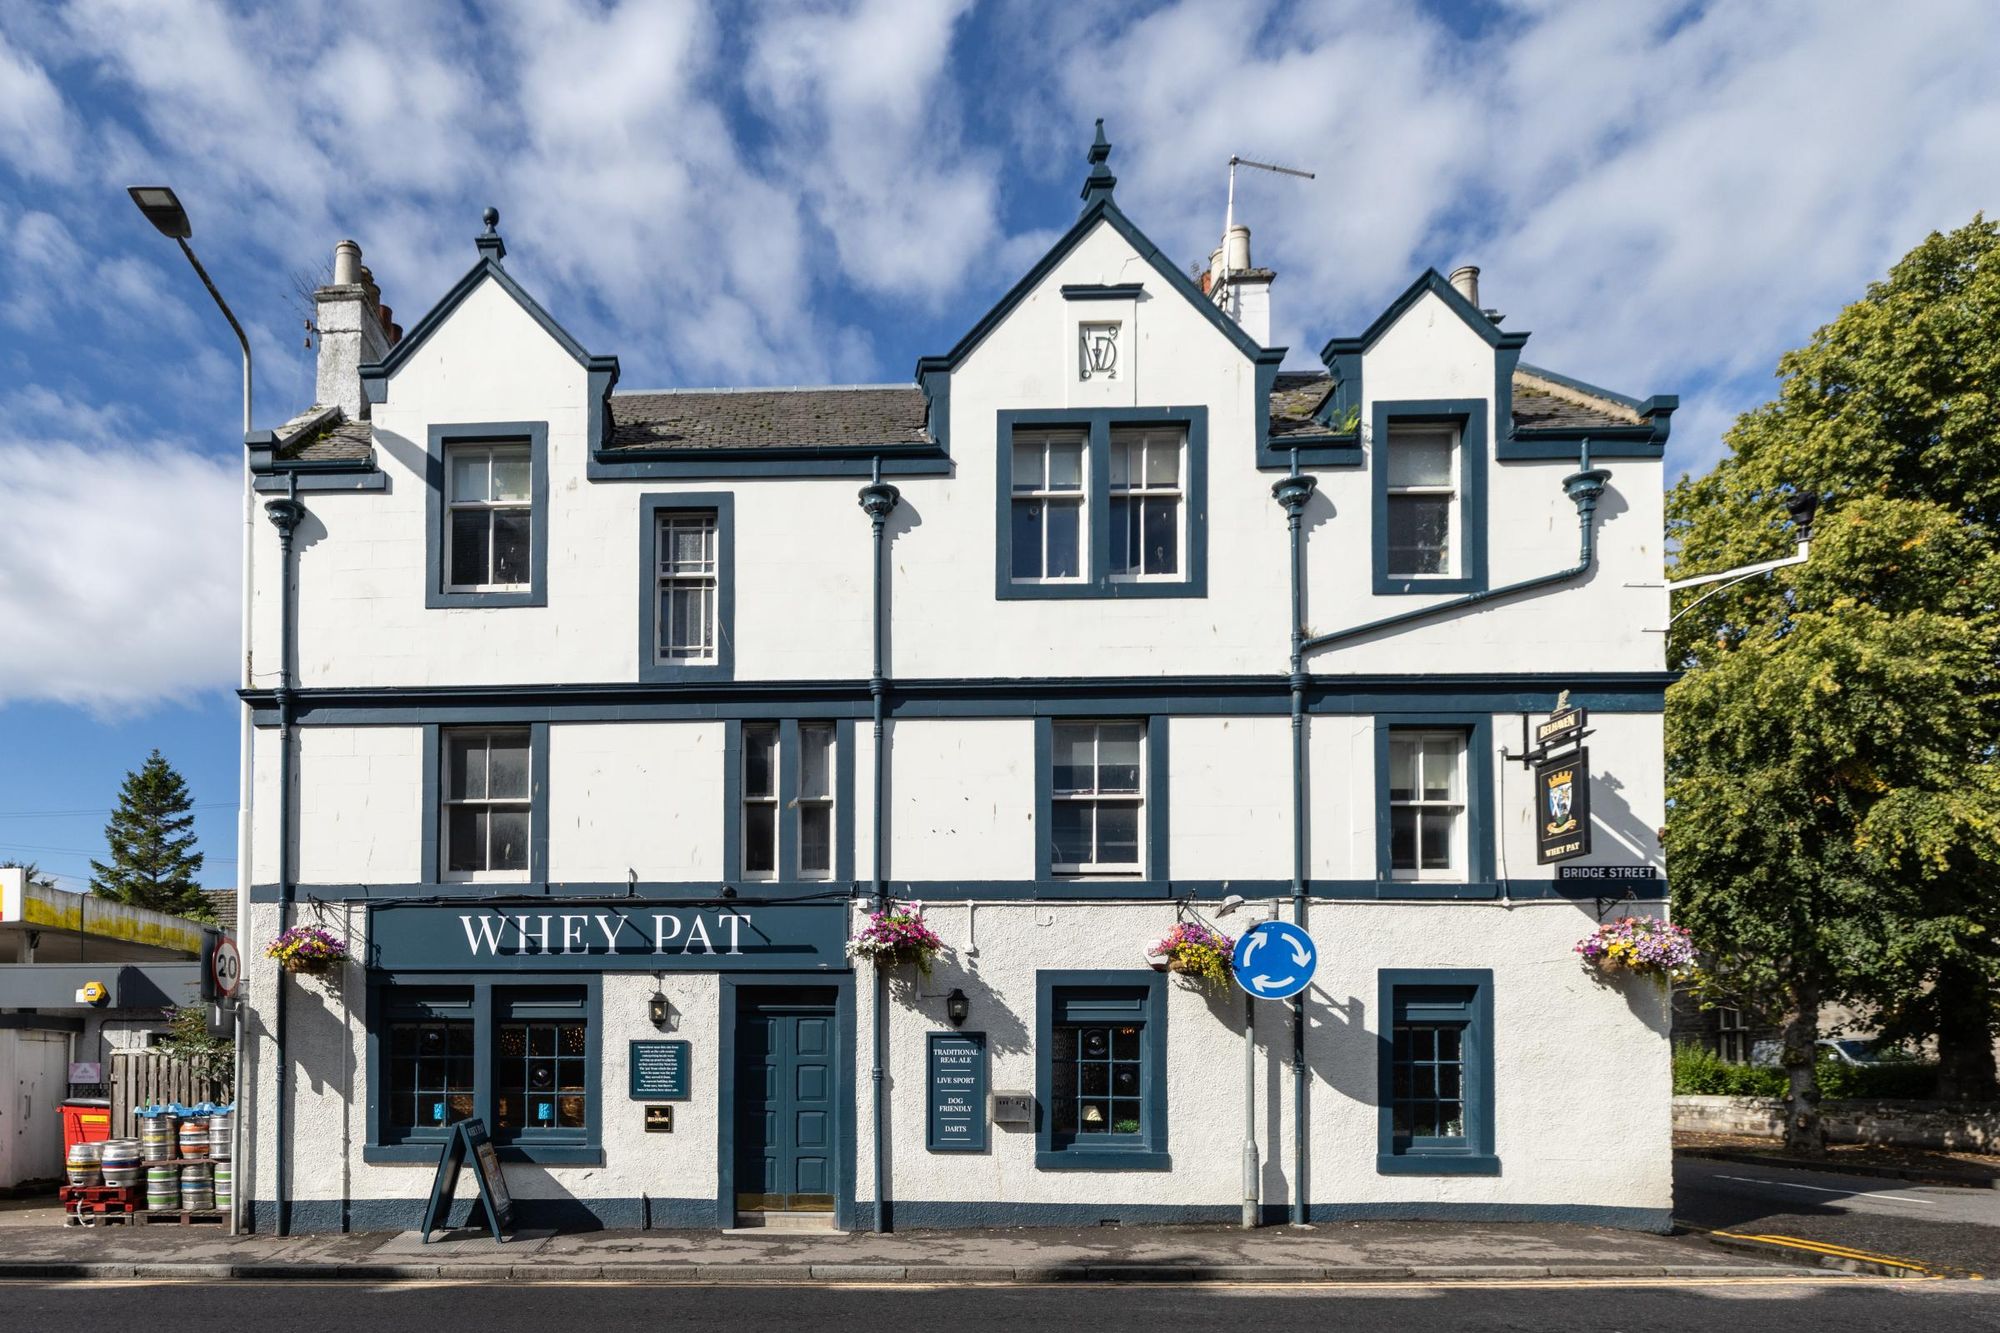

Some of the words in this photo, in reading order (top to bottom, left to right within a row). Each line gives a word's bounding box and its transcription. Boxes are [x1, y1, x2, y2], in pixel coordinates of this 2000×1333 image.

[1540, 713, 1575, 739] BELHAVEN
[1545, 846, 1565, 857] WHEY
[1566, 842, 1580, 851] PAT
[1563, 868, 1606, 878] BRIDGE
[1609, 867, 1653, 878] STREET
[459, 914, 629, 956] WHEY
[651, 913, 751, 955] PAT
[218, 954, 237, 979] 20
